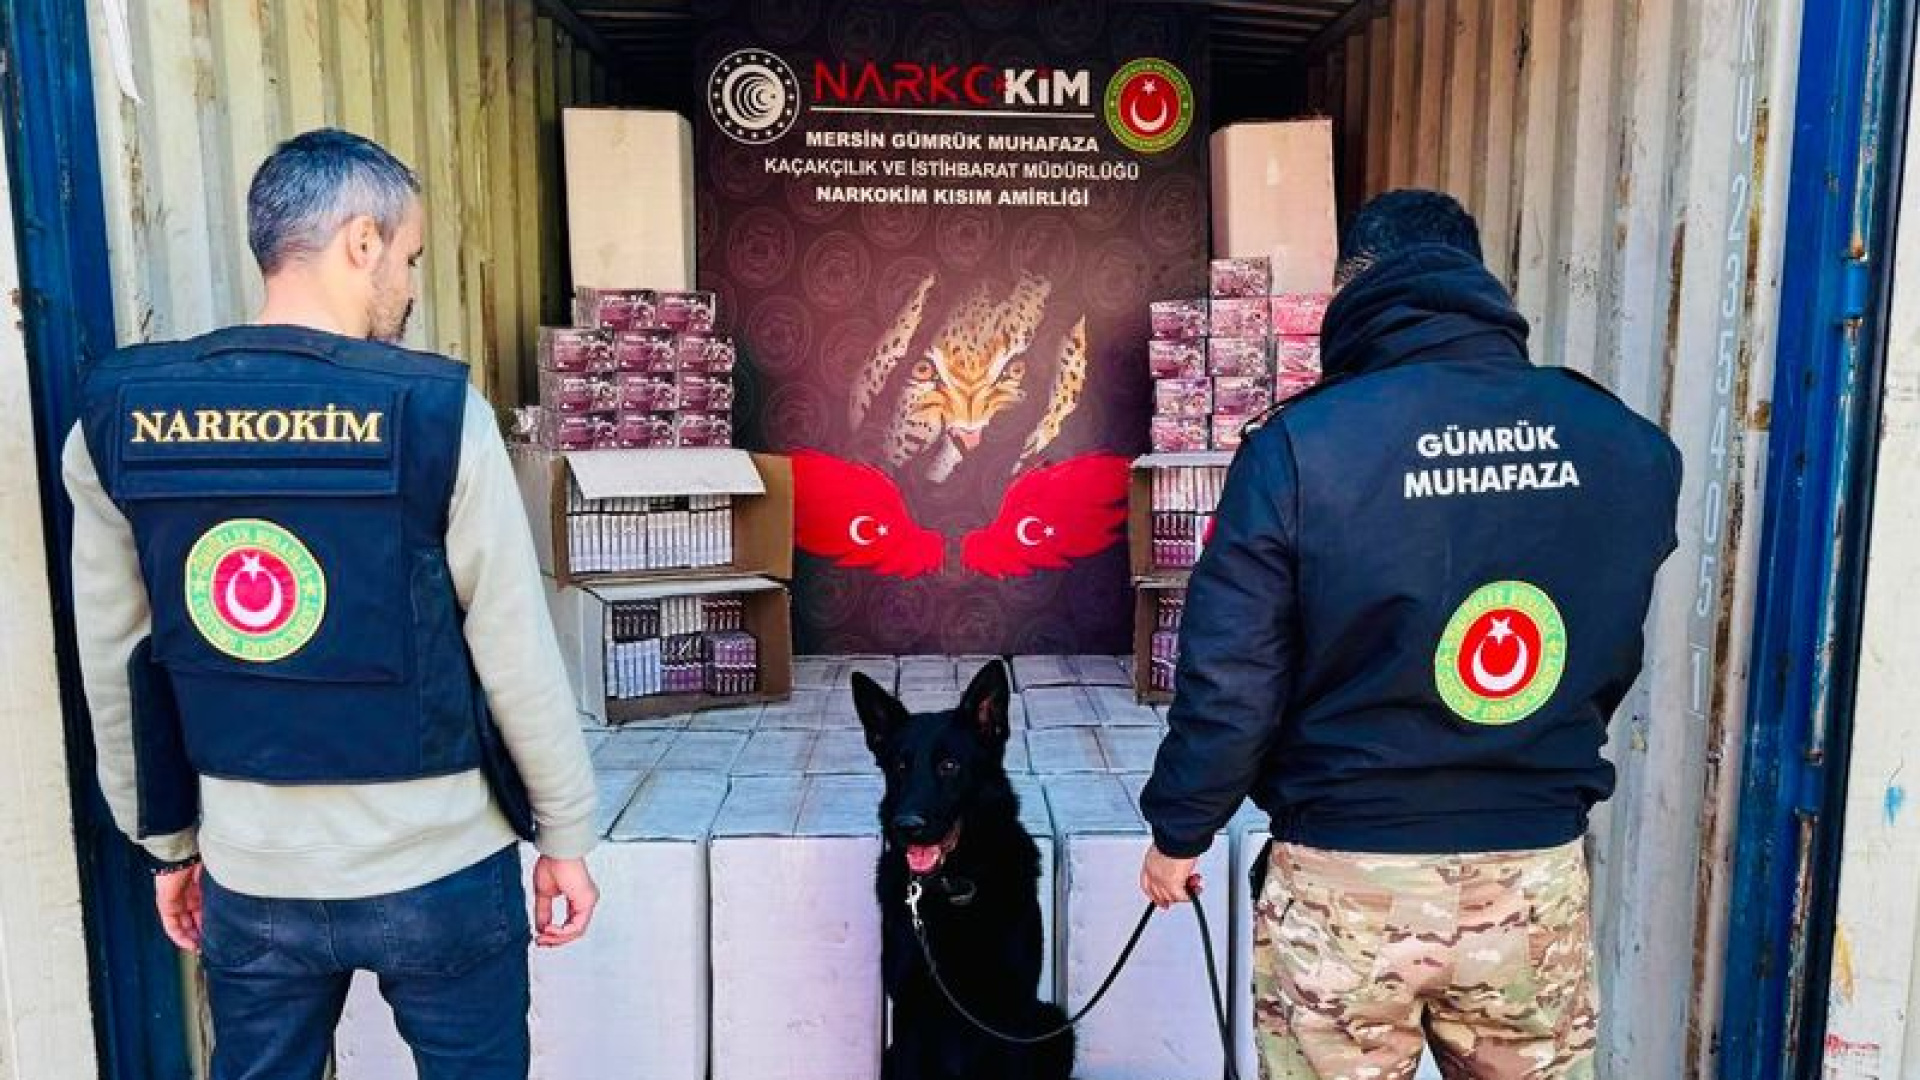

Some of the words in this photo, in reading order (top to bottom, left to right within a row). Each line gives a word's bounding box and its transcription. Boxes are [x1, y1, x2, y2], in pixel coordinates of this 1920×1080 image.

[806, 129, 885, 148] MERSİN
[892, 130, 983, 150] GÜMRÜK
[988, 135, 1100, 152] MUHAFAZA
[764, 157, 877, 178] KAÇAKÇILIK
[882, 160, 906, 176] VE
[911, 157, 1019, 179] İSTİHBARAT
[1024, 160, 1140, 181] MÜDÜRLÜĞÜ
[816, 185, 927, 204] NARKOKİM
[933, 188, 992, 205] KISIM
[998, 187, 1089, 207] AMİRLİĞİ
[131, 403, 384, 443] NARKOKİM
[1417, 420, 1560, 459] GÜMRÜK
[1404, 461, 1580, 499] MUHAFAZA
